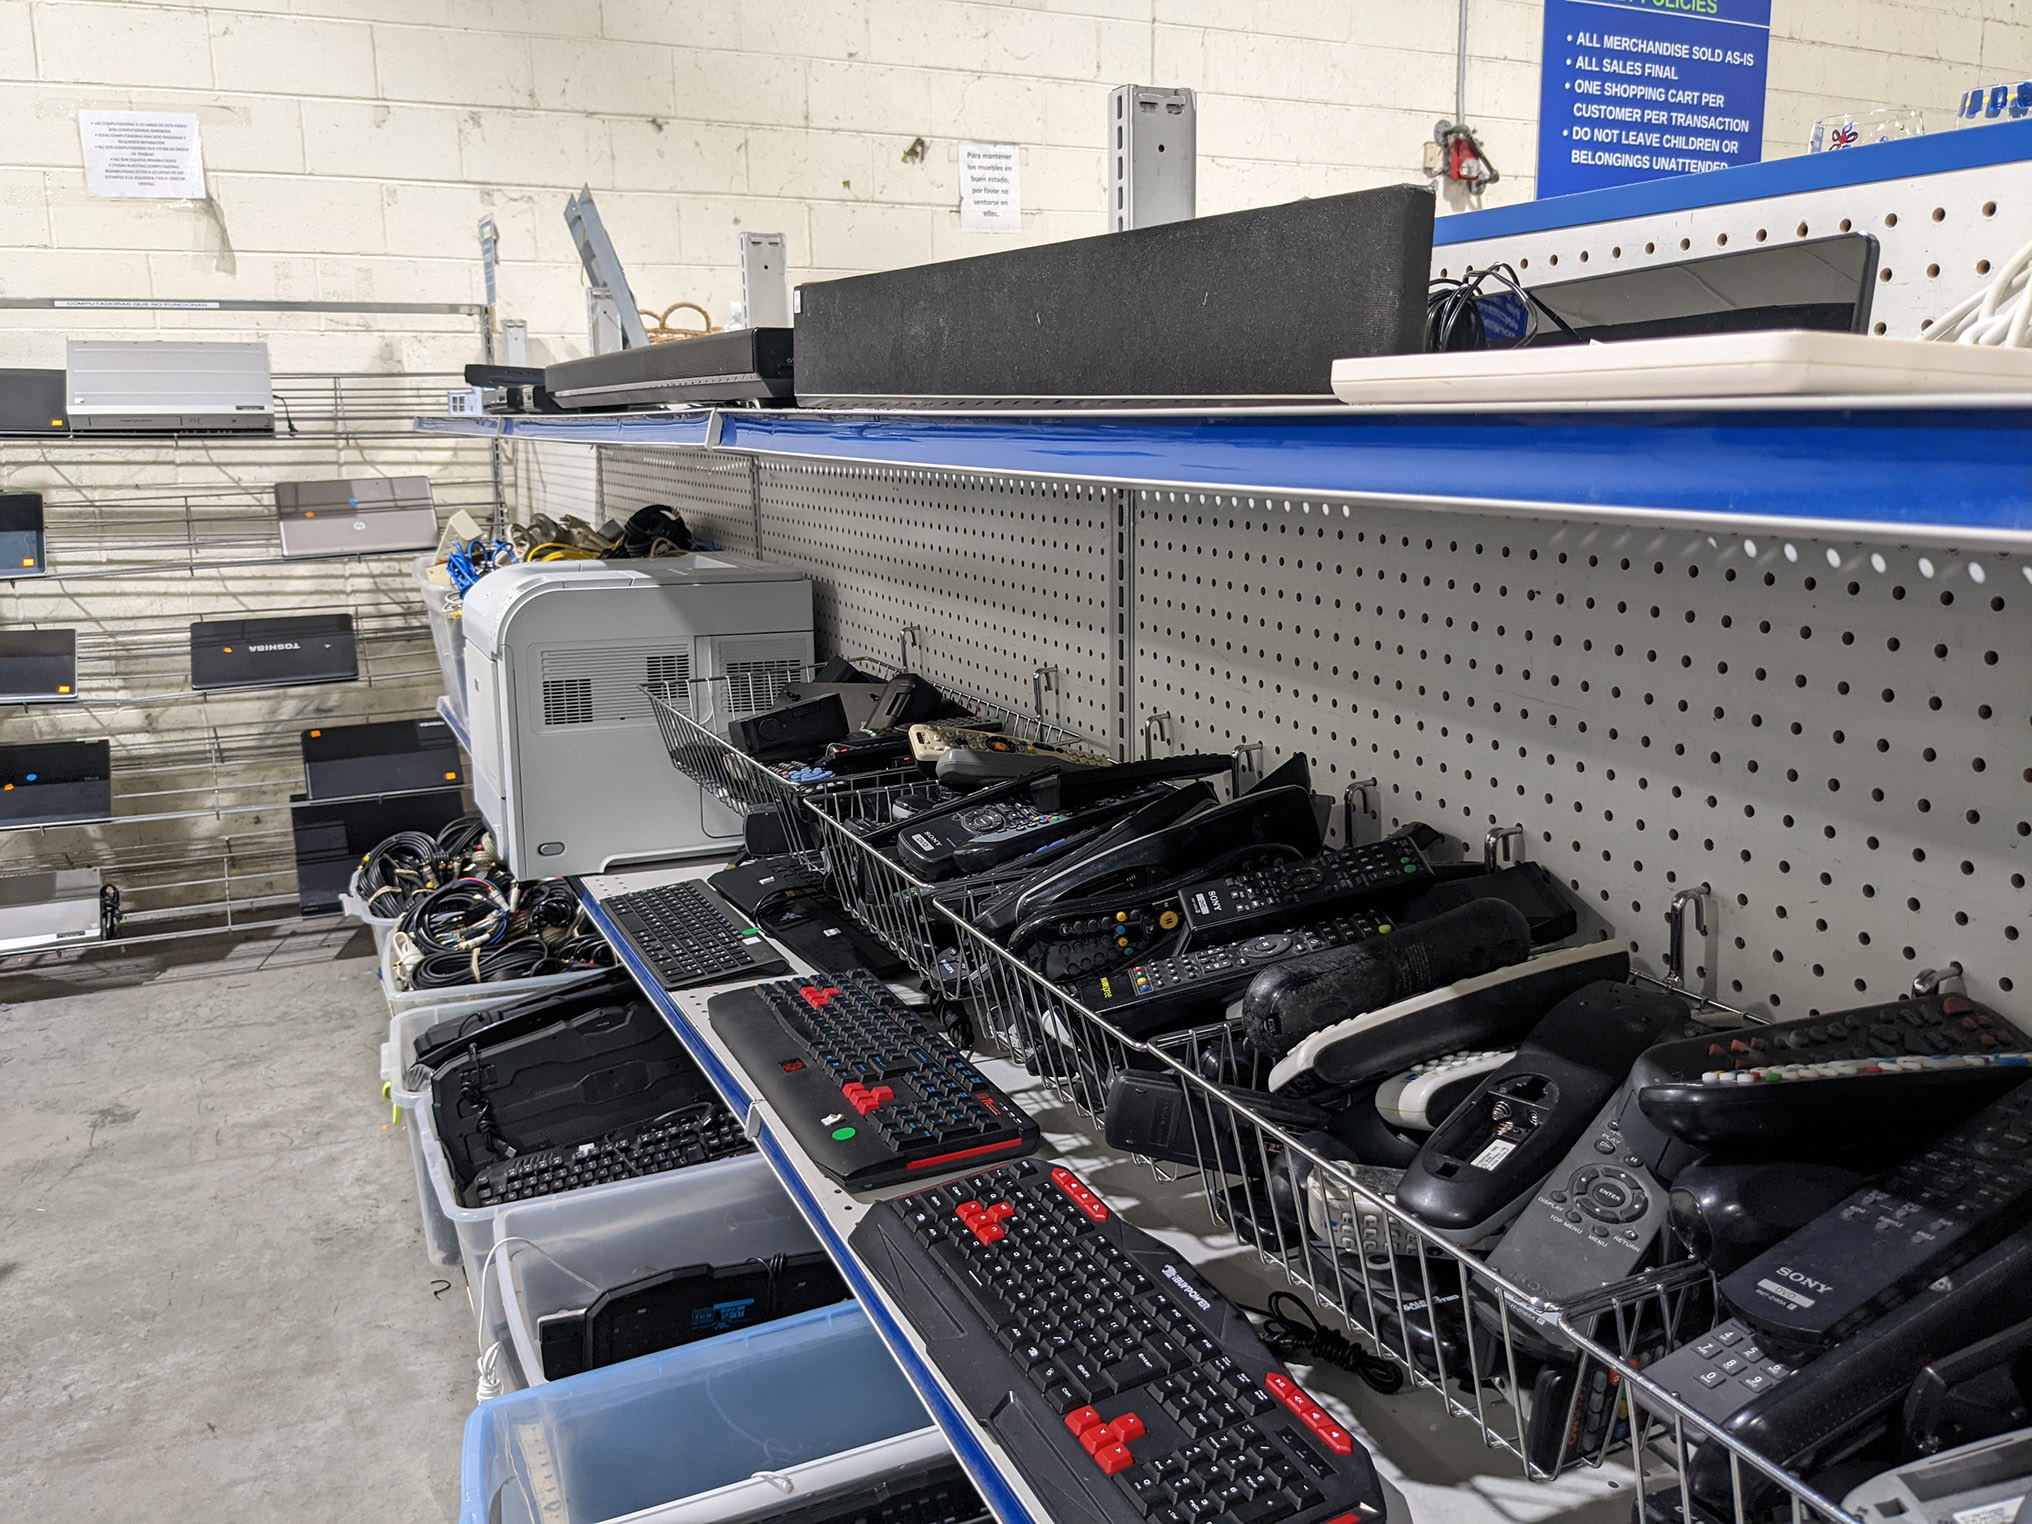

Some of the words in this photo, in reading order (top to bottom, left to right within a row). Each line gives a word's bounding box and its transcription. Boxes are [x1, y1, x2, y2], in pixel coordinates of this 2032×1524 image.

[1576, 32, 1601, 47] ALL
[1603, 34, 1690, 58] MERCHANDISE
[1692, 46, 1723, 62] SOLD
[1725, 50, 1755, 66] AS-IS
[1575, 56, 1600, 71] ALL
[1602, 58, 1642, 76] SALES
[1644, 64, 1679, 80] FINAL
[1574, 79, 1601, 95] ONE
[1604, 82, 1665, 102] SHOPPING
[1667, 88, 1699, 105] CART
[1701, 93, 1725, 108] PER
[1573, 103, 1642, 122] CUSTOMER
[1644, 110, 1668, 124] PER
[1670, 112, 1749, 132] TRANSACTION
[1572, 126, 1591, 141] DO
[1593, 129, 1619, 143] NOT
[1621, 132, 1660, 147] LEAVE
[1662, 135, 1720, 152] CHILDREN
[1722, 140, 1739, 154] OR
[1571, 149, 1650, 169] BELONGINGS
[249, 642, 301, 653] TOSHIBA
[924, 831, 943, 847] SONY
[1208, 890, 1222, 911] SONY
[1601, 1133, 1621, 1144] PLAY
[1538, 1196, 1563, 1212] DISPLAY
[1599, 1188, 1621, 1201] ENTER
[1549, 1214, 1563, 1224] TOP
[1563, 1221, 1583, 1234] MENU
[1588, 1234, 1608, 1247] MENU
[1613, 1235, 1640, 1252] RETURN
[1776, 1266, 1833, 1293] SONY
[1775, 1287, 1795, 1298] DVD
